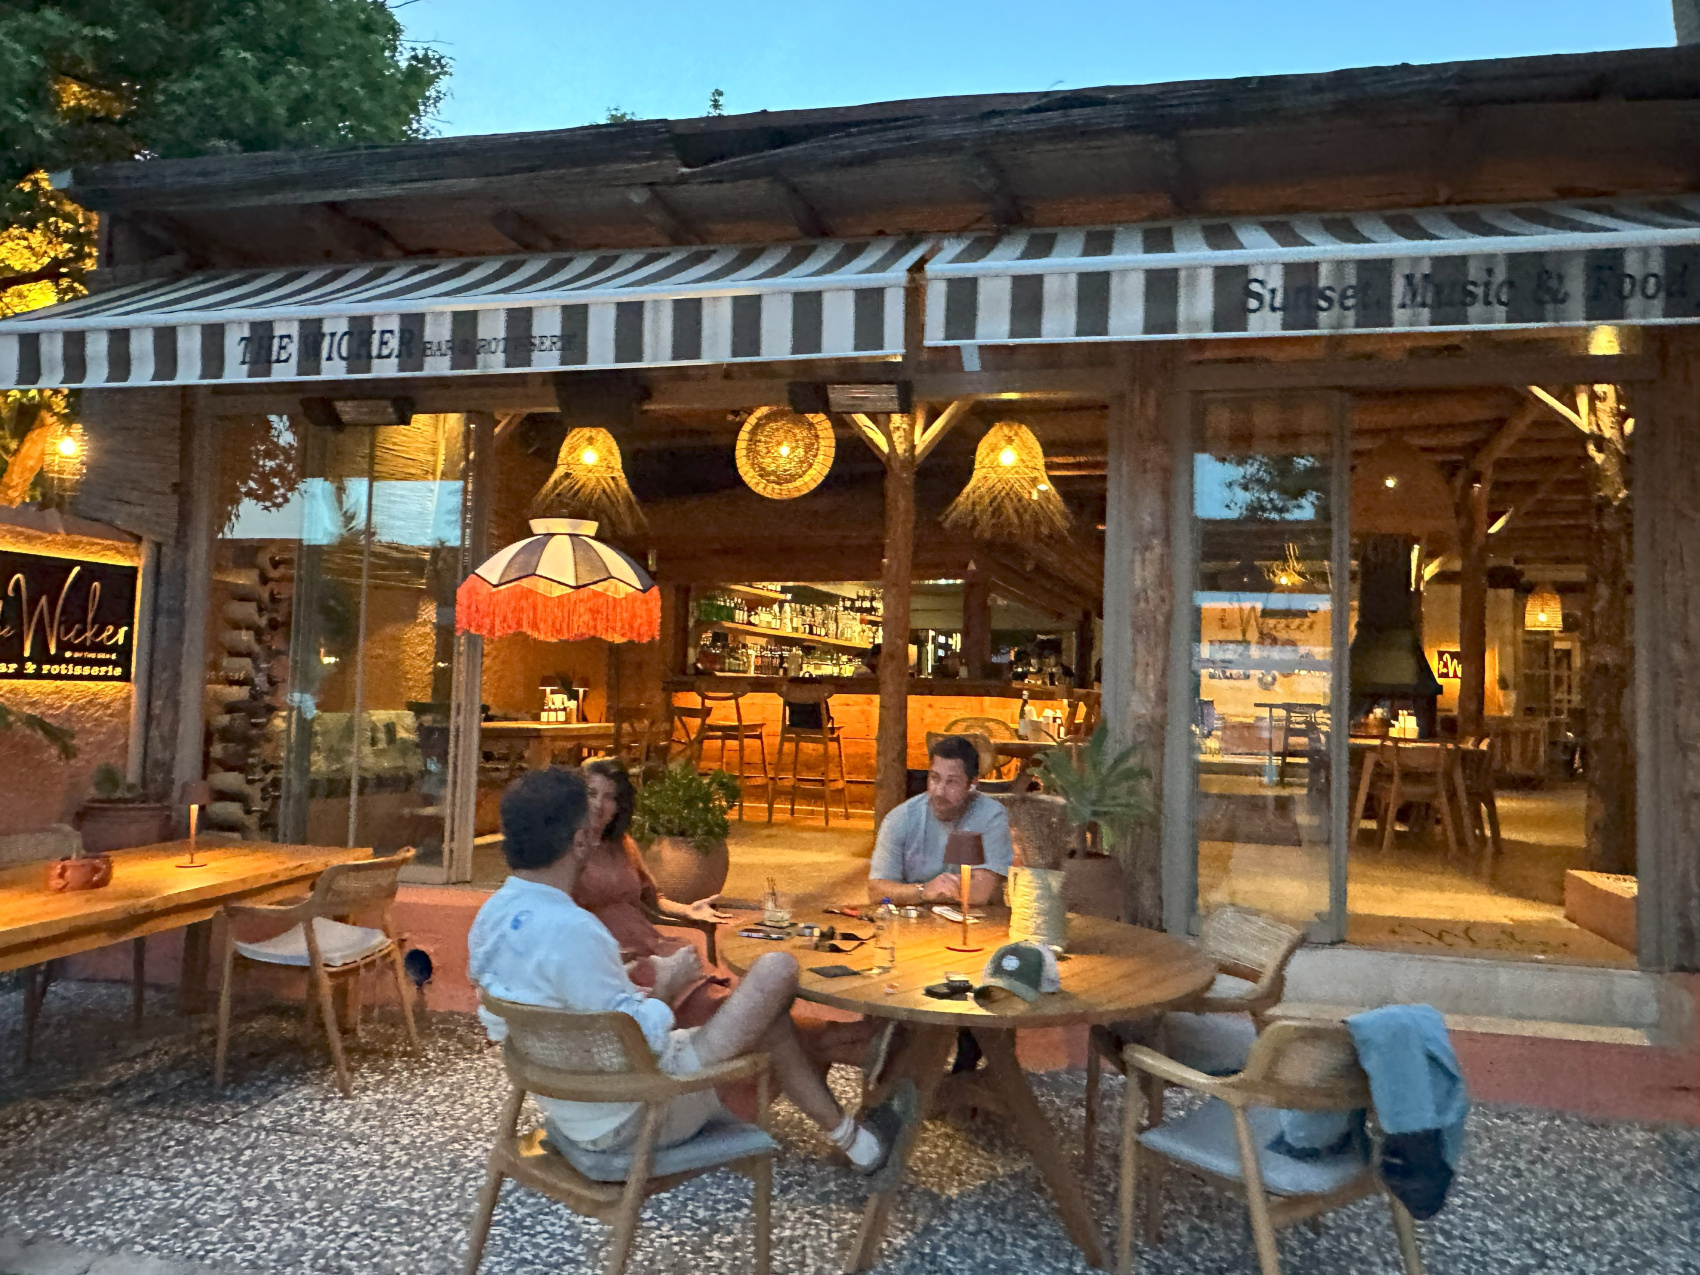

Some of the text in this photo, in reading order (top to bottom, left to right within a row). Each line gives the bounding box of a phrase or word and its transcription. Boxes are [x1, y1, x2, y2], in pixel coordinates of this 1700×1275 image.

[1399, 267, 1515, 309] Music
[1536, 269, 1568, 304] &
[1588, 262, 1690, 301] Food
[238, 334, 294, 366] THE
[302, 328, 415, 362] WICKER
[8, 566, 128, 657] Wicker
[42, 663, 122, 676] rotisserie
